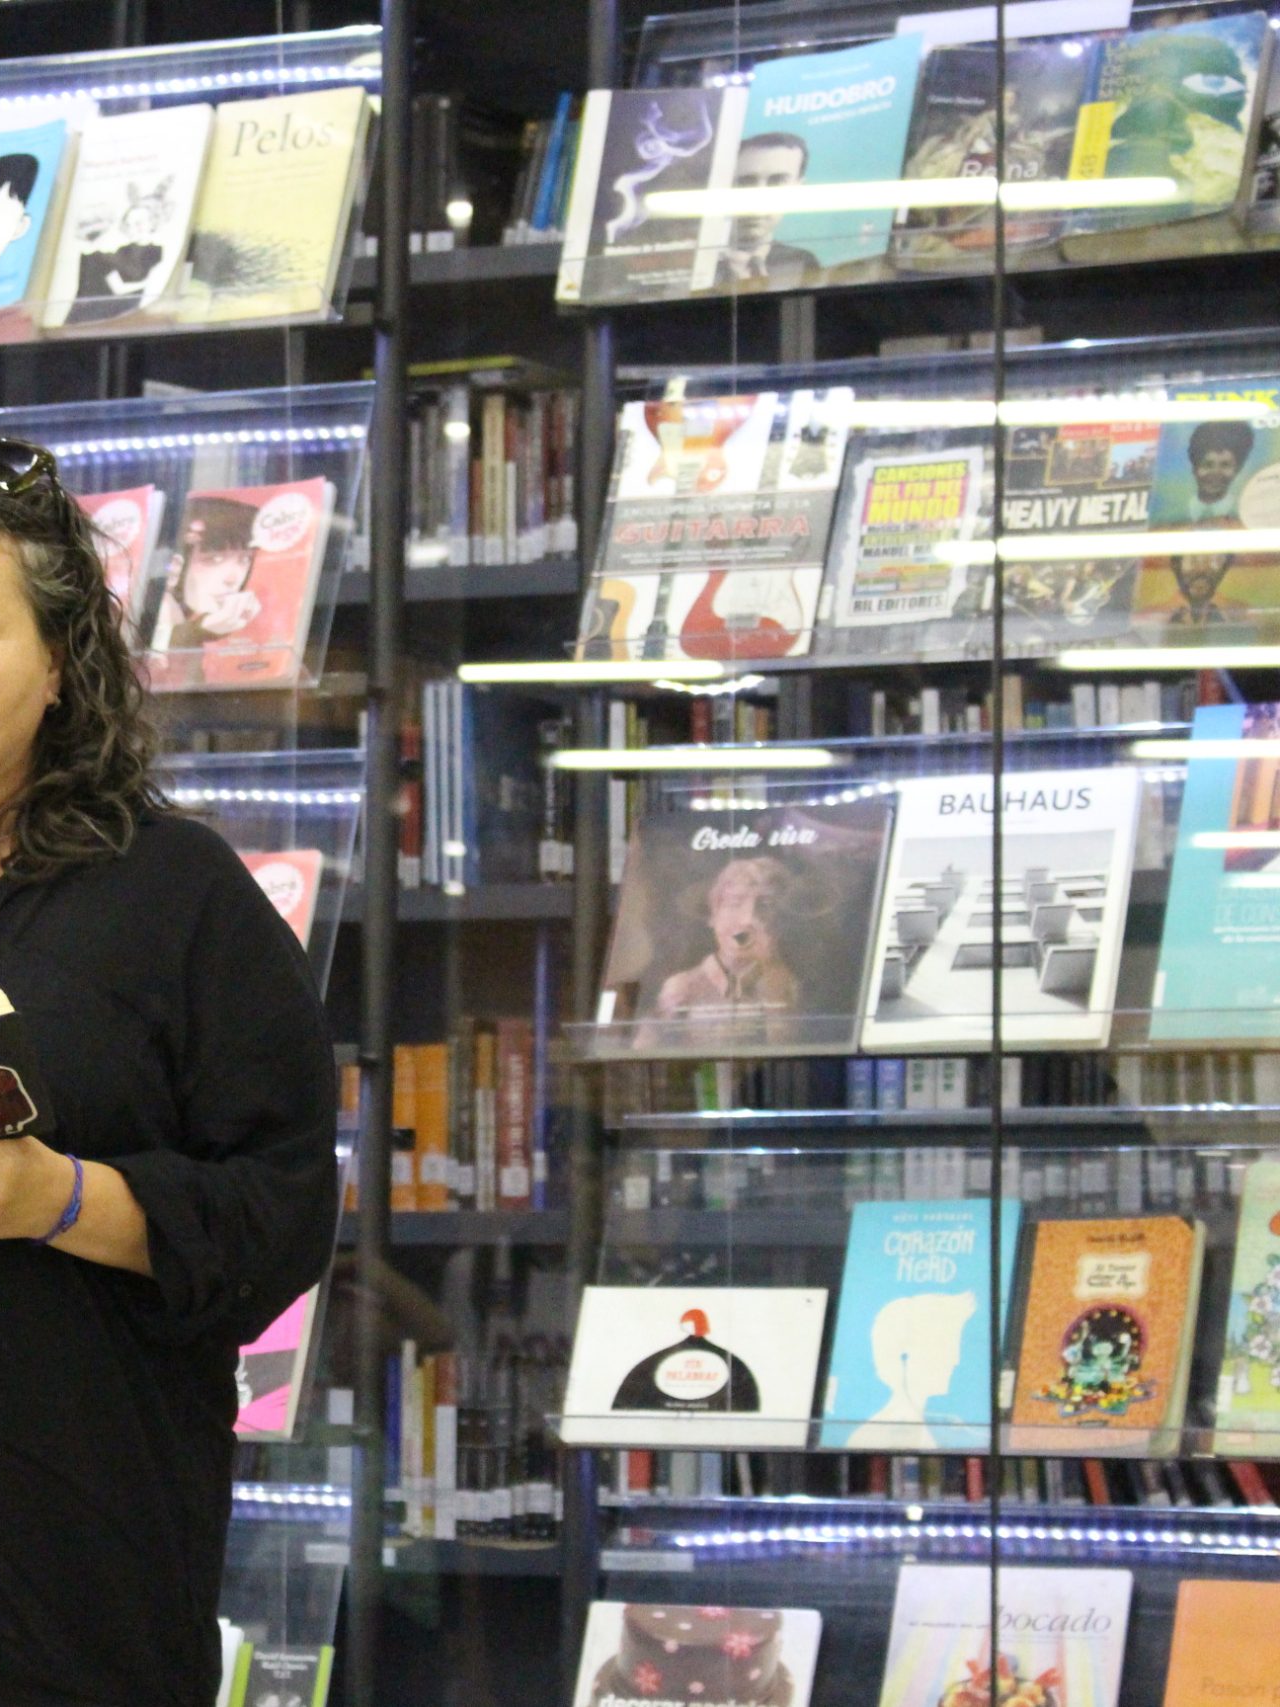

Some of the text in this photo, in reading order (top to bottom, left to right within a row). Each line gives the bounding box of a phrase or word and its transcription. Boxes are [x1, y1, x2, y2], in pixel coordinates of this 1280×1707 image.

[764, 75, 896, 117] HUIDOBRO
[233, 112, 335, 157] Pelos
[874, 461, 967, 484] CANCIONES
[867, 498, 960, 525] MUNDO
[1002, 490, 1150, 530] HEAVY METAL
[614, 515, 810, 545] GUITARRA
[939, 787, 1093, 815] BAUHAUS
